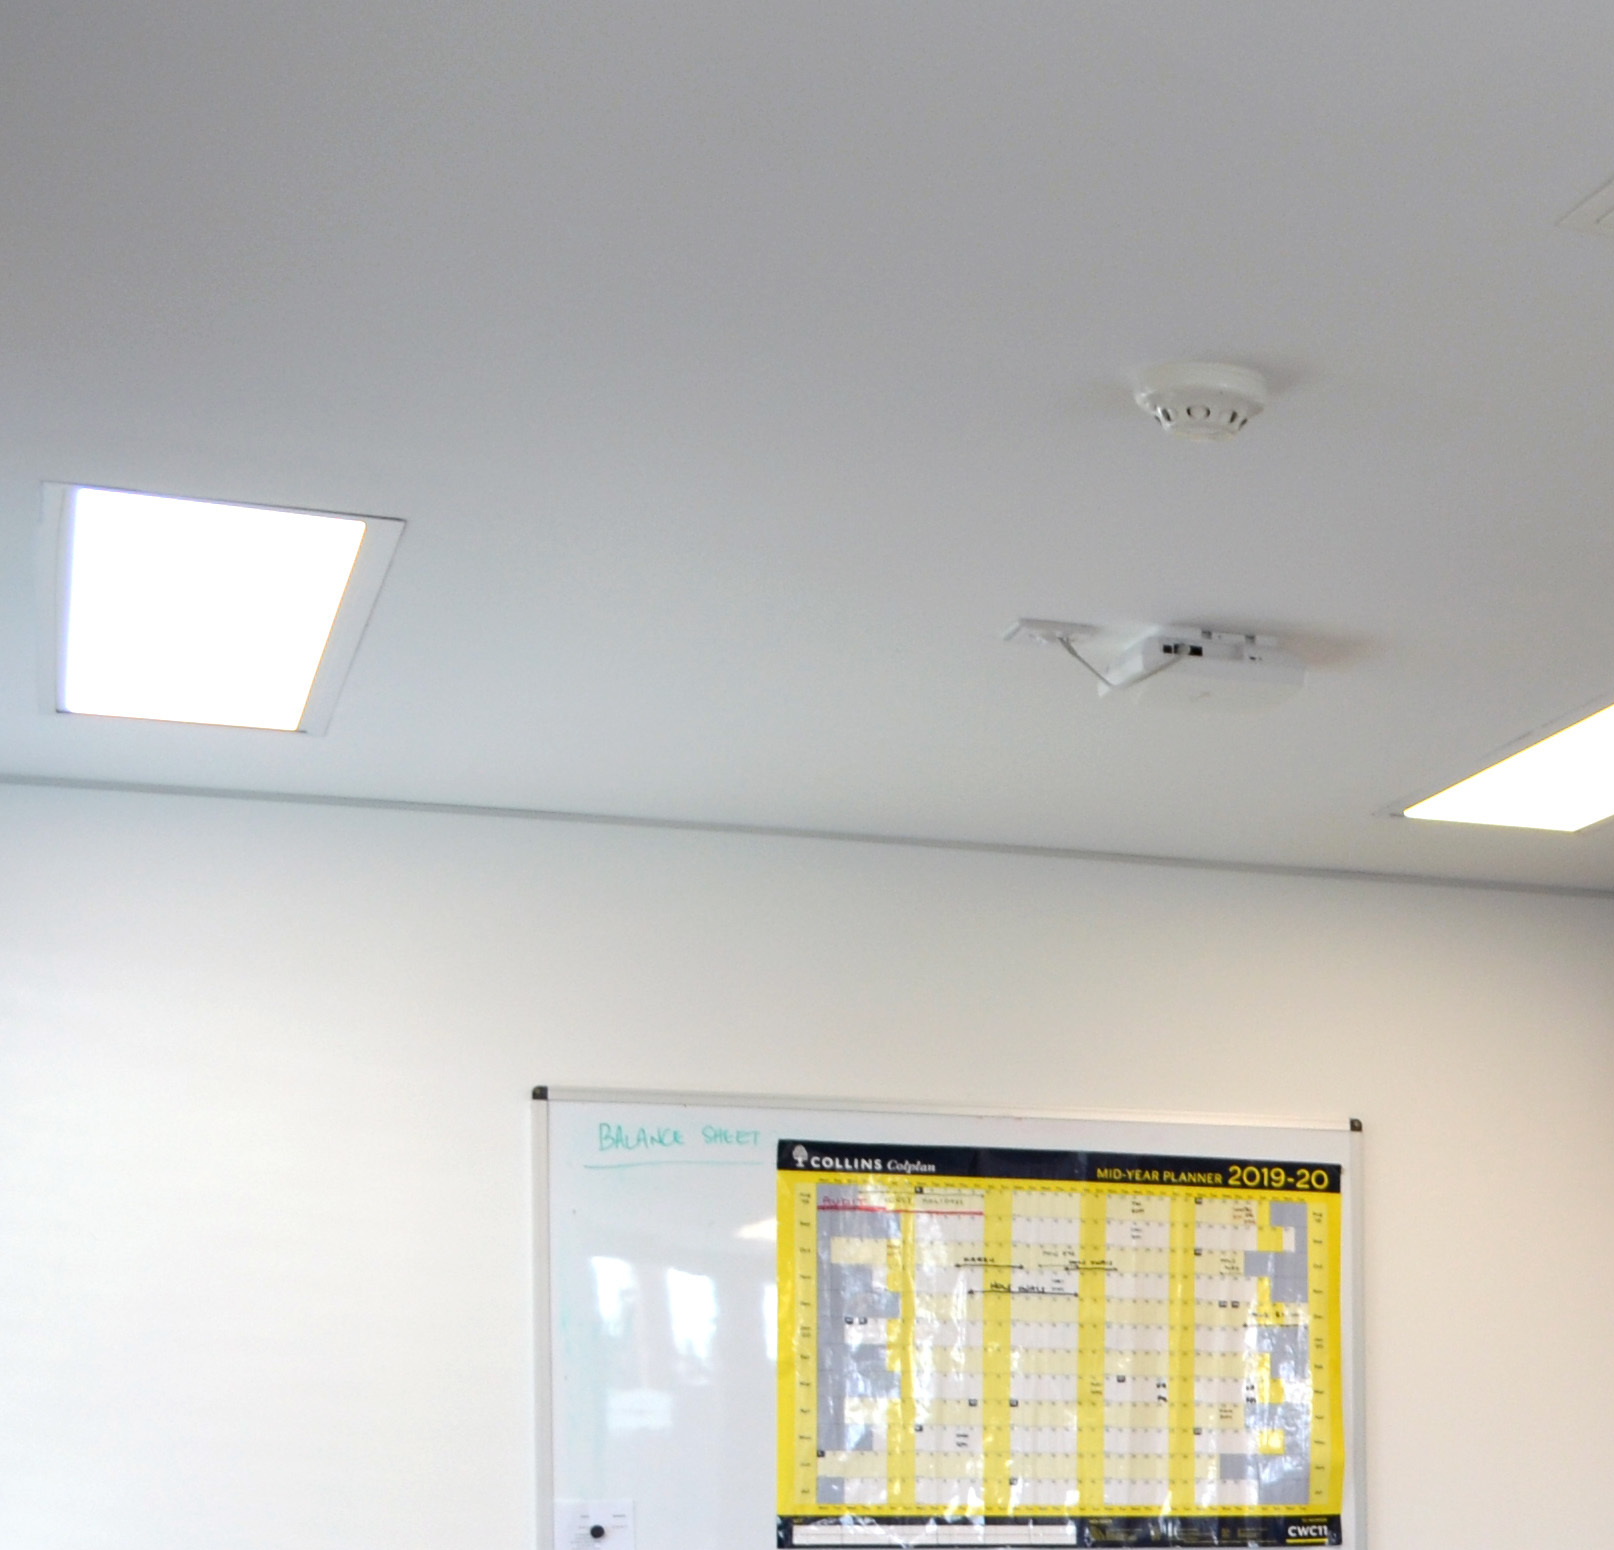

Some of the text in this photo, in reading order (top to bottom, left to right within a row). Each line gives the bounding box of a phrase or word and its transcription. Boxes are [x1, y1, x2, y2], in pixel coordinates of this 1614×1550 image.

[599, 1122, 760, 1151] BALANCE SHEET
[810, 1156, 936, 1174] COLLINS Colplan
[1096, 1165, 1329, 1190] MID-YEAR PLANNER 2019-20
[1287, 1525, 1329, 1537] CWC11
